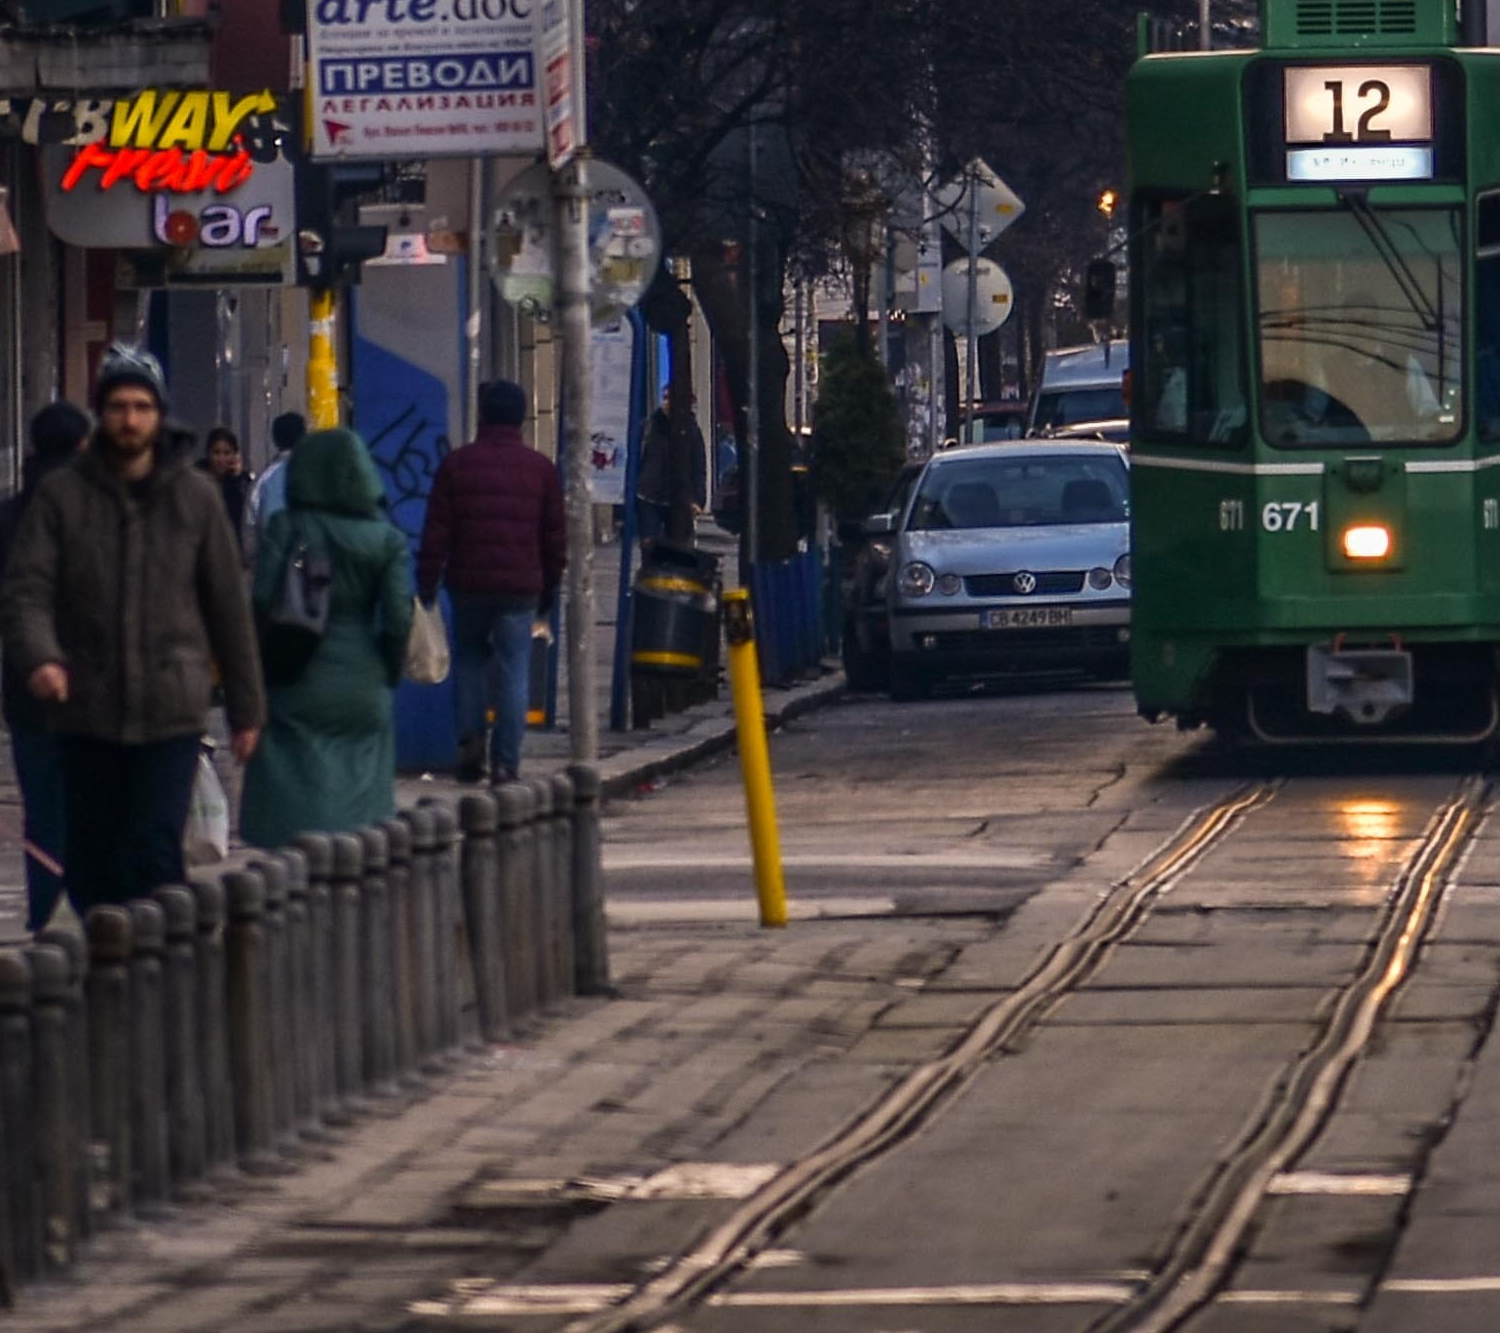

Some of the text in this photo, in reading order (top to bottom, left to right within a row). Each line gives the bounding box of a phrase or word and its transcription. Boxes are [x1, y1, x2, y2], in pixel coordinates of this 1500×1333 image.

[323, 55, 530, 92] ПРЕВОДИ
[321, 92, 537, 115] ЛЕГАЛИЗАЦИЯ
[1323, 79, 1392, 142] 12
[154, 193, 272, 247] bar
[1261, 501, 1319, 531] 671
